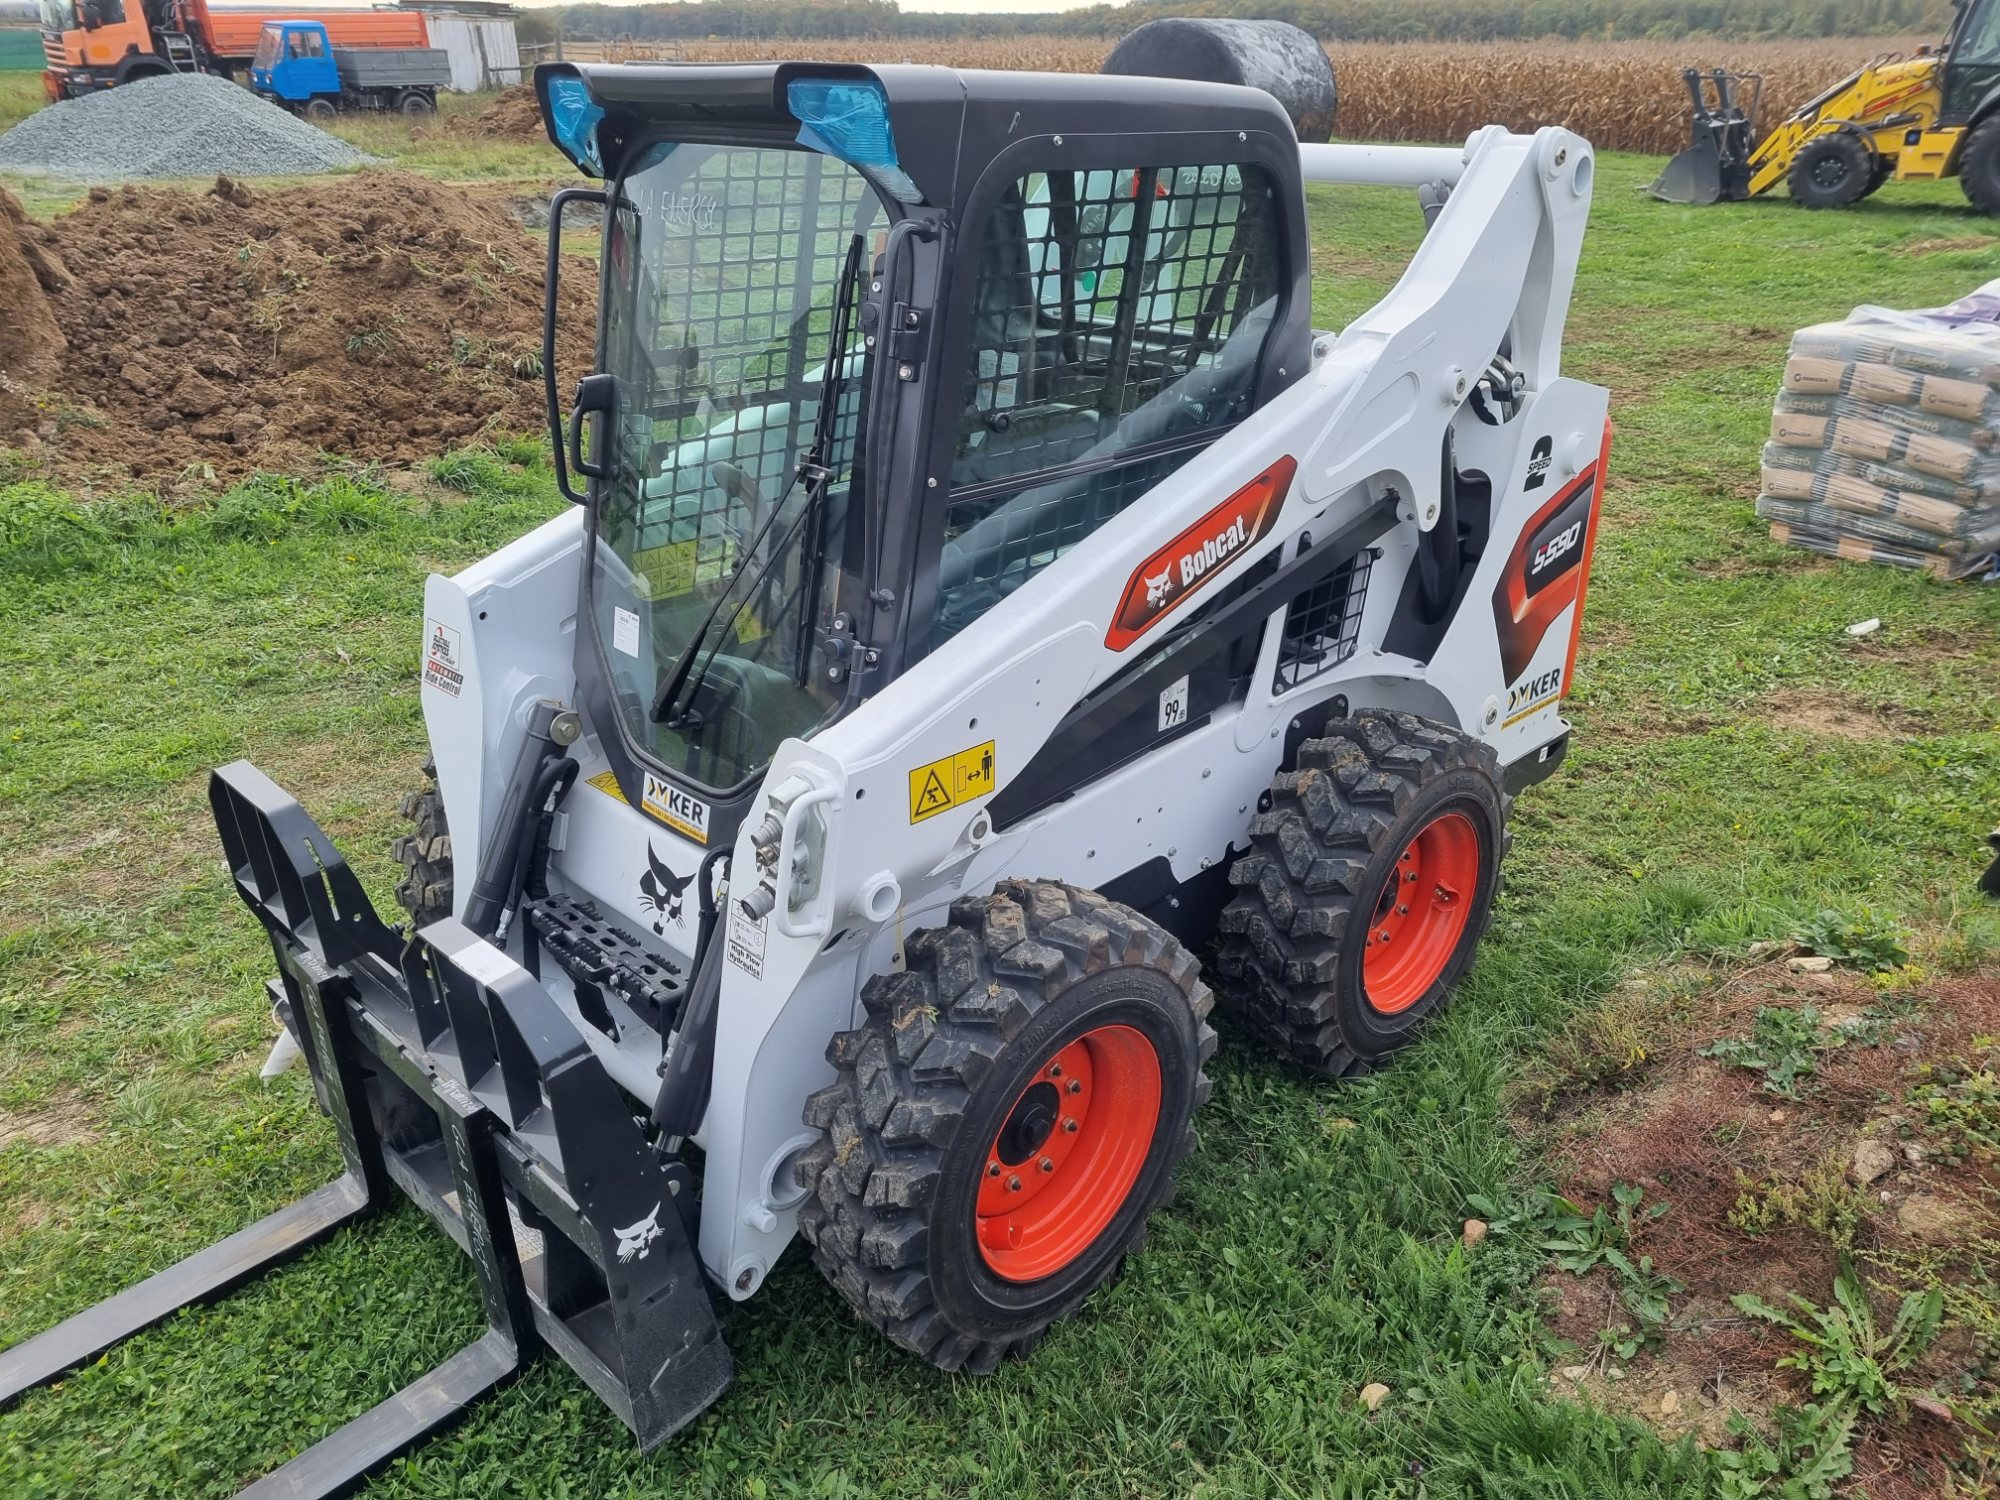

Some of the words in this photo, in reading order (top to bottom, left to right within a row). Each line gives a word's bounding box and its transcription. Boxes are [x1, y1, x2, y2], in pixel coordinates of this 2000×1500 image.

[1527, 456, 1553, 475] SPEED
[1179, 514, 1246, 587] Bobcat
[1531, 520, 1582, 576] S590
[425, 669, 439, 685] Ride
[438, 676, 461, 696] Control
[428, 660, 463, 685] AUTOMATIC
[1165, 699, 1179, 726] 99
[729, 950, 761, 977] Hydraulics
[731, 943, 745, 958] High
[746, 952, 761, 967] Flow
